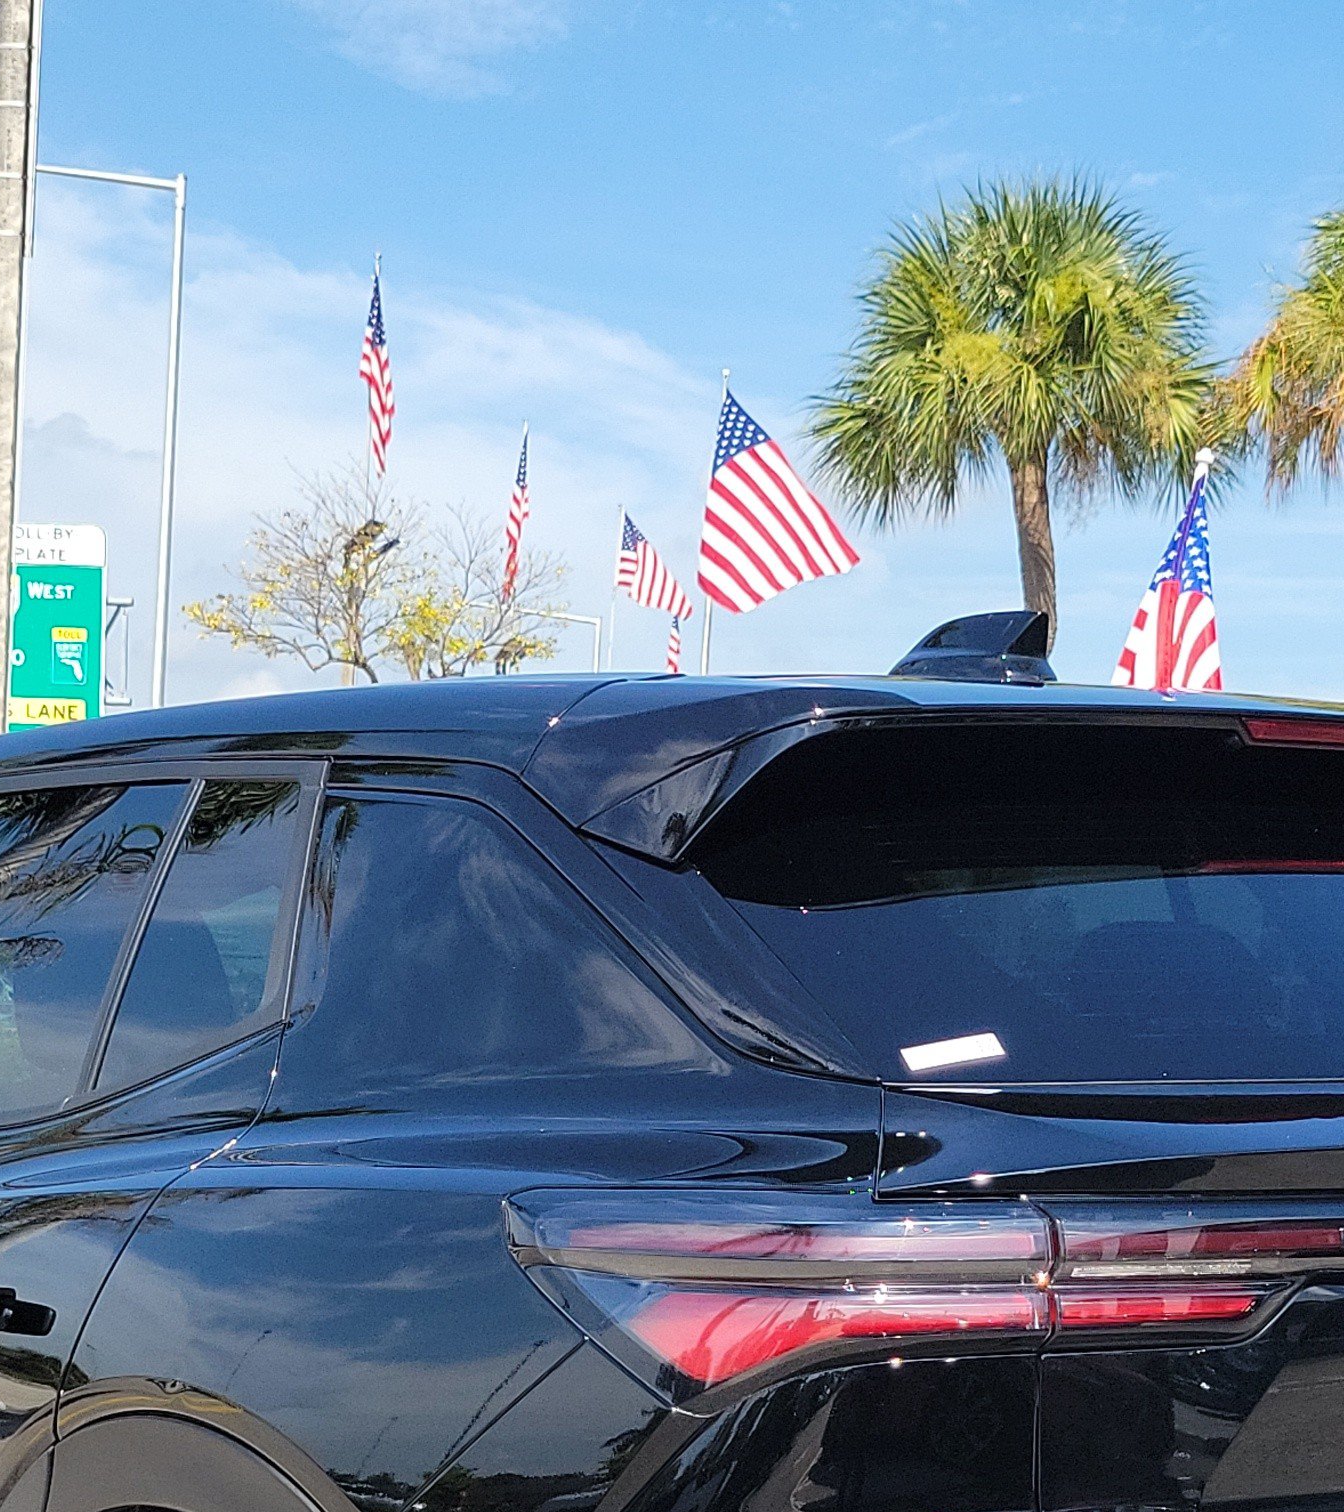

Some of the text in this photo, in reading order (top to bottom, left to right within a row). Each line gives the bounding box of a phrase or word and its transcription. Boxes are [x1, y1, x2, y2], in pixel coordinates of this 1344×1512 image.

[14, 547, 66, 562] PLATE
[26, 581, 75, 600] WEST
[26, 703, 78, 721] LANE
